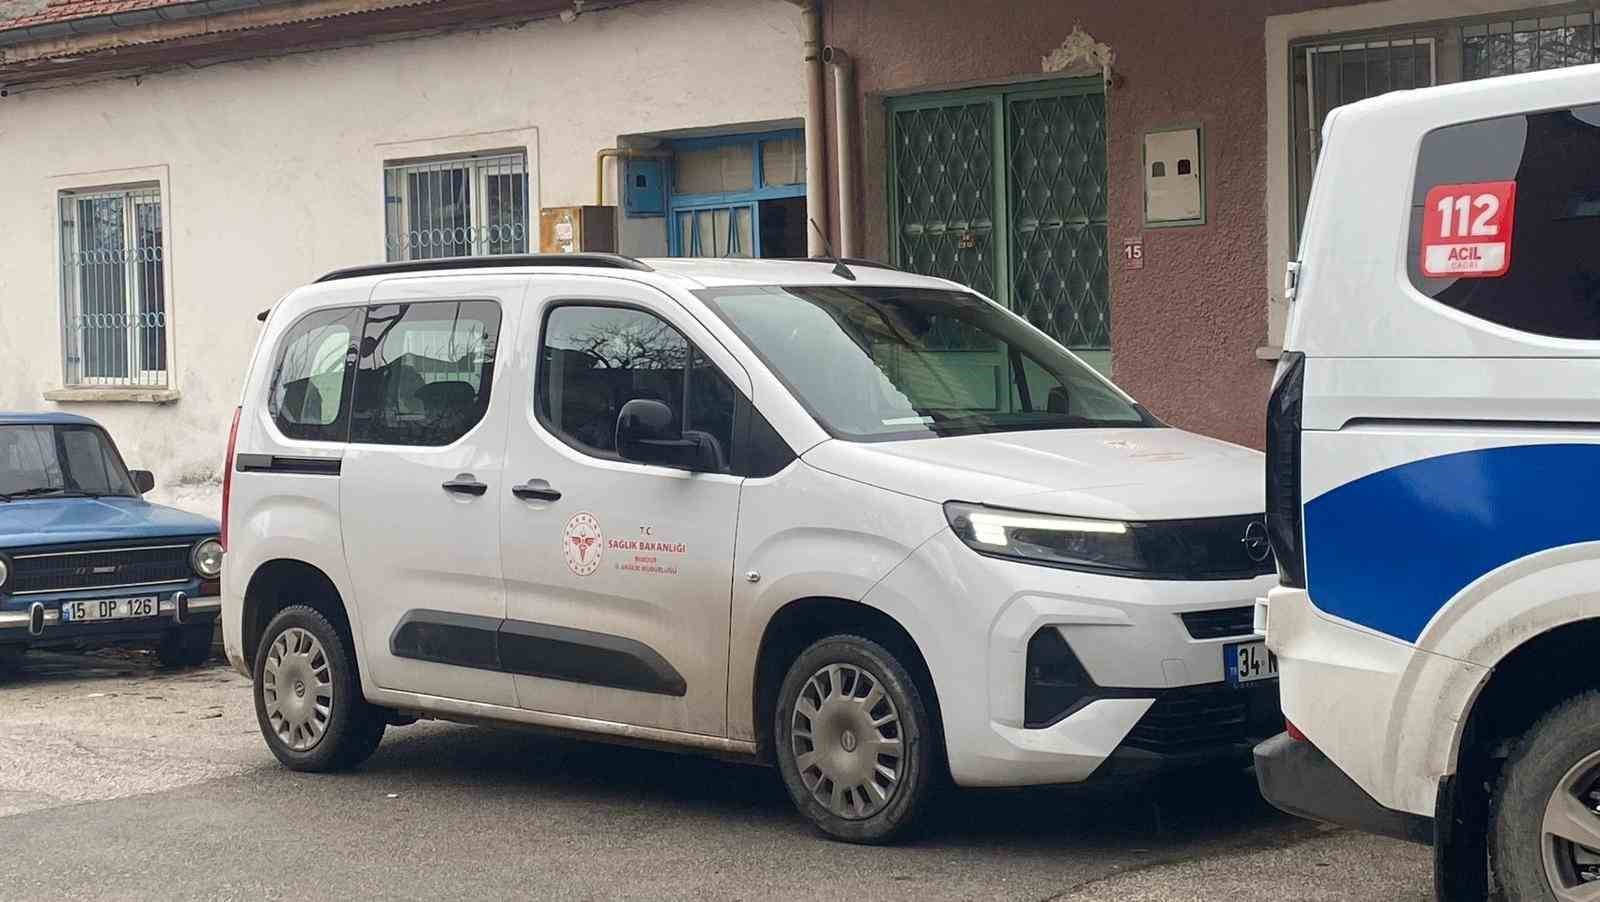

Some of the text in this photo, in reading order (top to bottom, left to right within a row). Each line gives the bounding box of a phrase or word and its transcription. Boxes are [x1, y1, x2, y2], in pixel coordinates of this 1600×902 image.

[1437, 193, 1499, 238] 112
[1124, 245, 1141, 259] 15
[71, 598, 152, 619] 15 DP 126
[1239, 646, 1260, 677] 34
